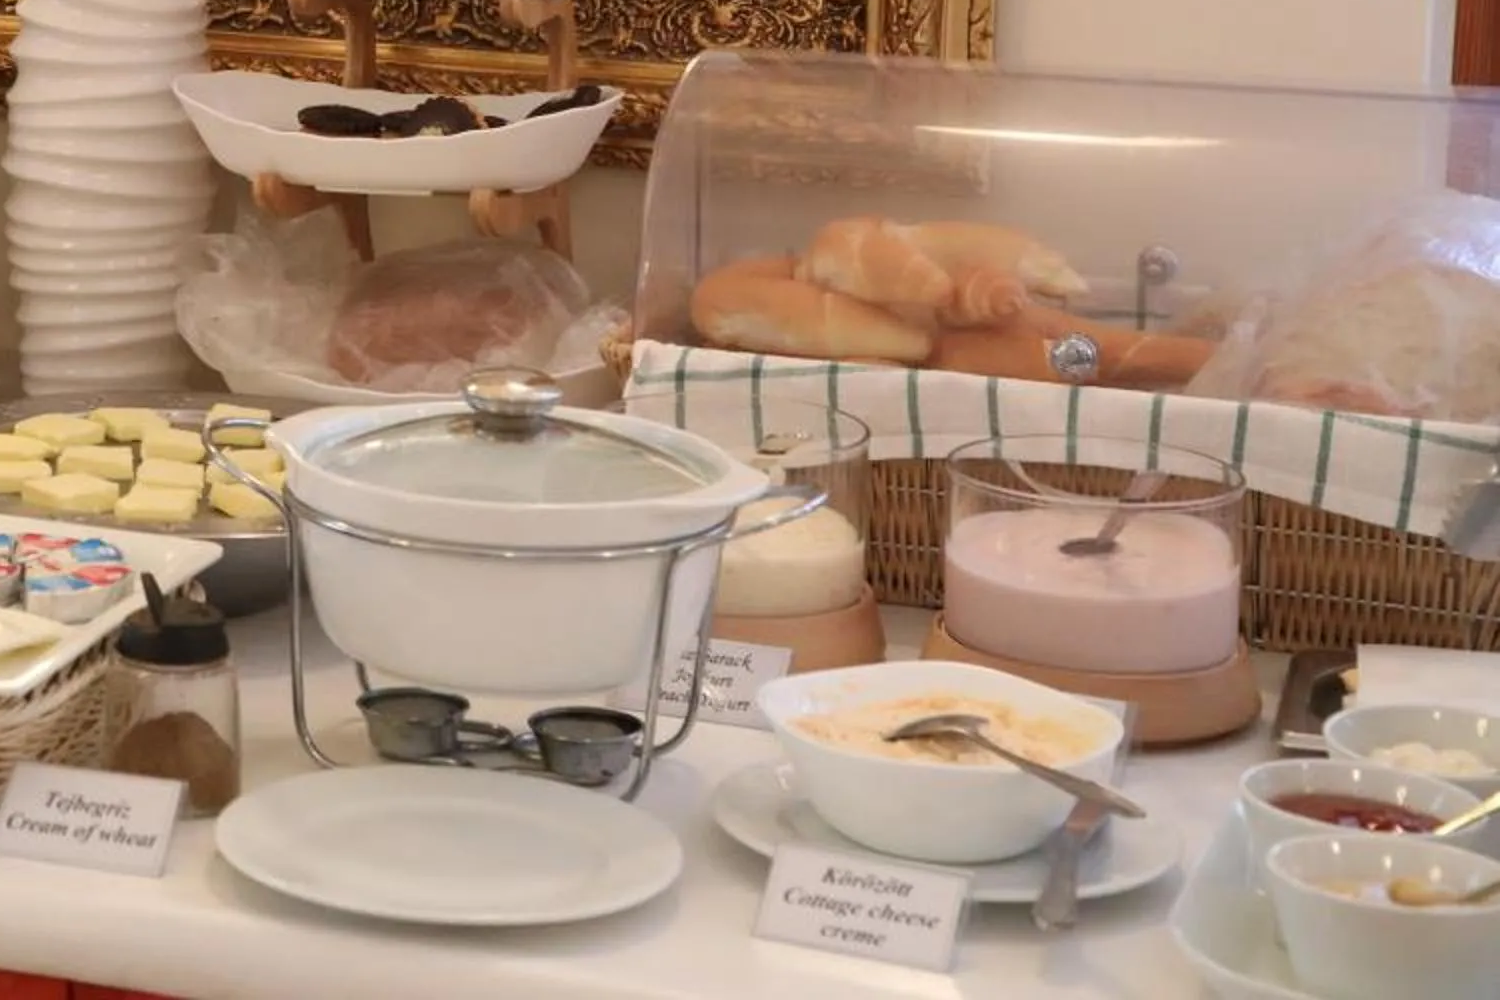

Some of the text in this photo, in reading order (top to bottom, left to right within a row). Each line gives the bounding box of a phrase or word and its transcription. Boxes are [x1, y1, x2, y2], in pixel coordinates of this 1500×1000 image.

[5, 811, 158, 850] Cream of wheat
[782, 885, 942, 931] Cottage cheese
[818, 923, 888, 948] creme
